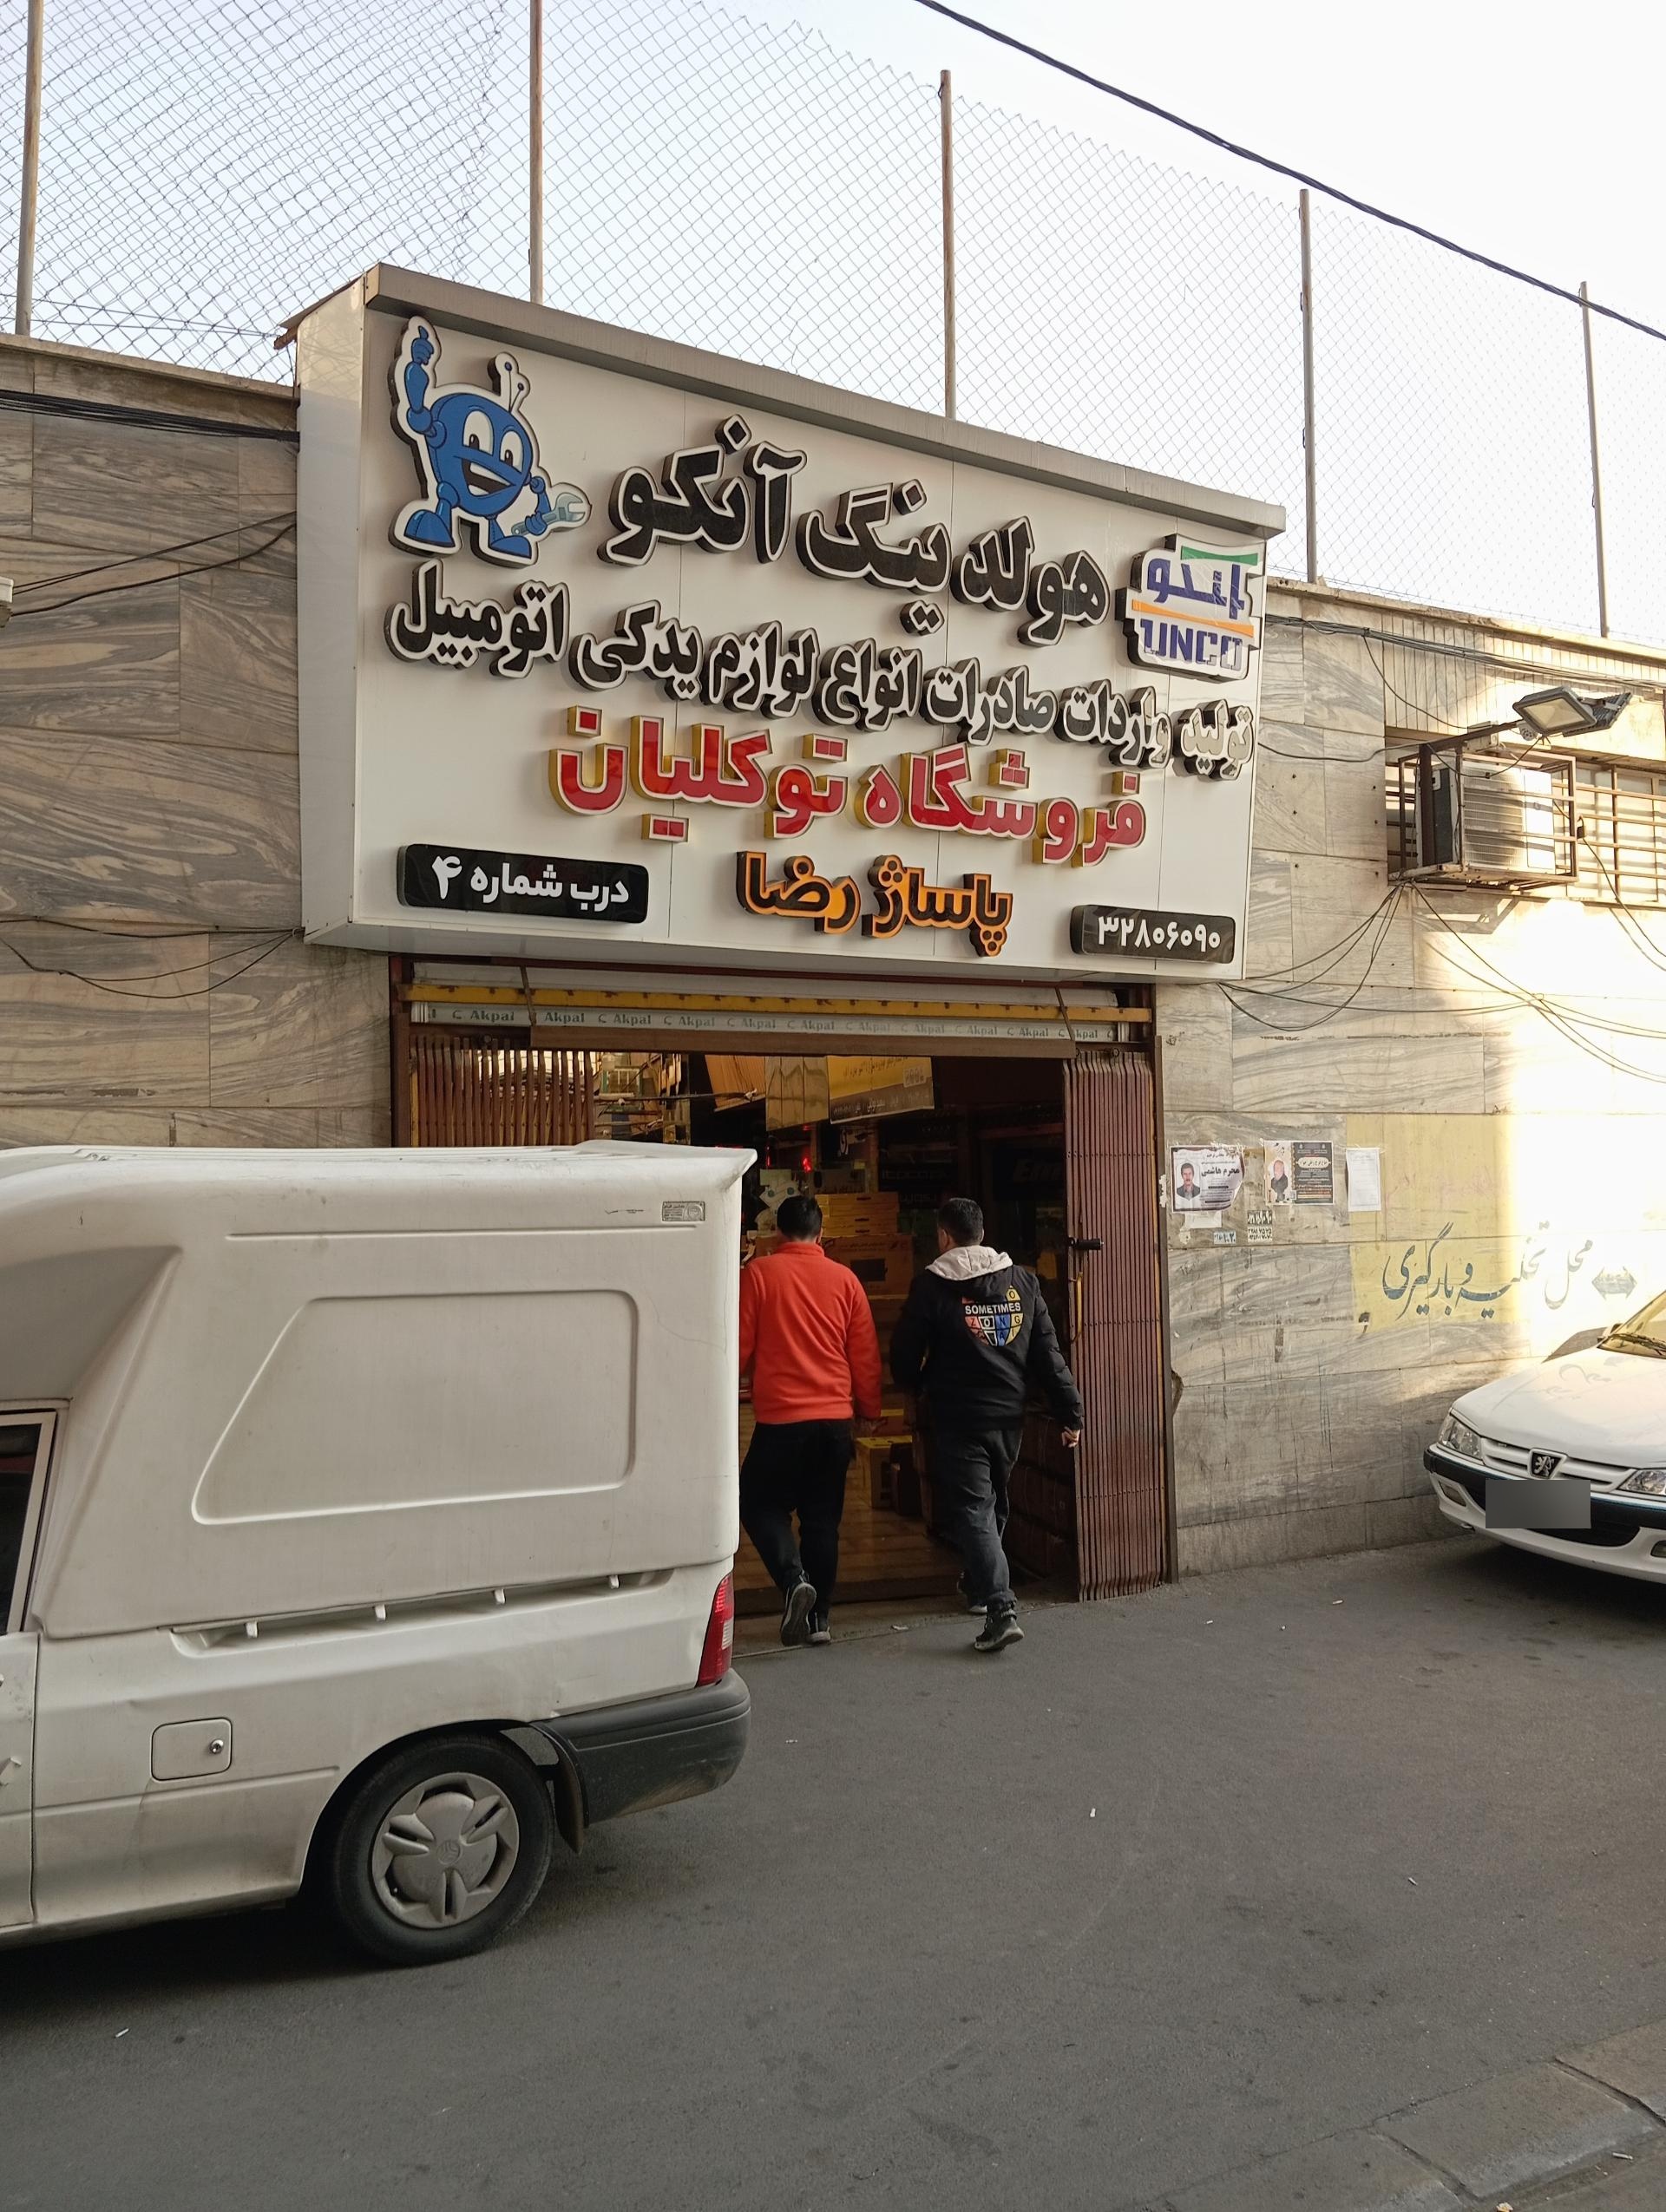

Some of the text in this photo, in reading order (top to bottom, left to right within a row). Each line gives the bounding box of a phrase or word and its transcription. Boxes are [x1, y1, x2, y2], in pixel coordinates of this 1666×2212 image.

[600, 415, 1109, 646] هولدینگ آنکو
[387, 560, 1254, 781] تولید واردات صادرات انواع لوازم یدکی اتومبیل
[1140, 618, 1243, 671] UNCO
[550, 705, 1147, 867] فروشگاه توکلیان
[431, 855, 630, 913] درب شماره ۴
[738, 851, 1013, 958] پاساژ رضا
[1098, 916, 1222, 953] ۳۲۸۰۶۰۹۰
[470, 1010, 515, 1022] Akpal
[545, 1011, 585, 1024] Akpal
[613, 1013, 652, 1025] Akpal
[1068, 1029, 1099, 1040] kpal
[965, 1302, 1021, 1315] SOMETIMES
[1381, 1221, 1454, 1321] بارگیری
[1454, 1220, 1547, 1319] تخلیه
[1544, 1239, 1594, 1311] محل
